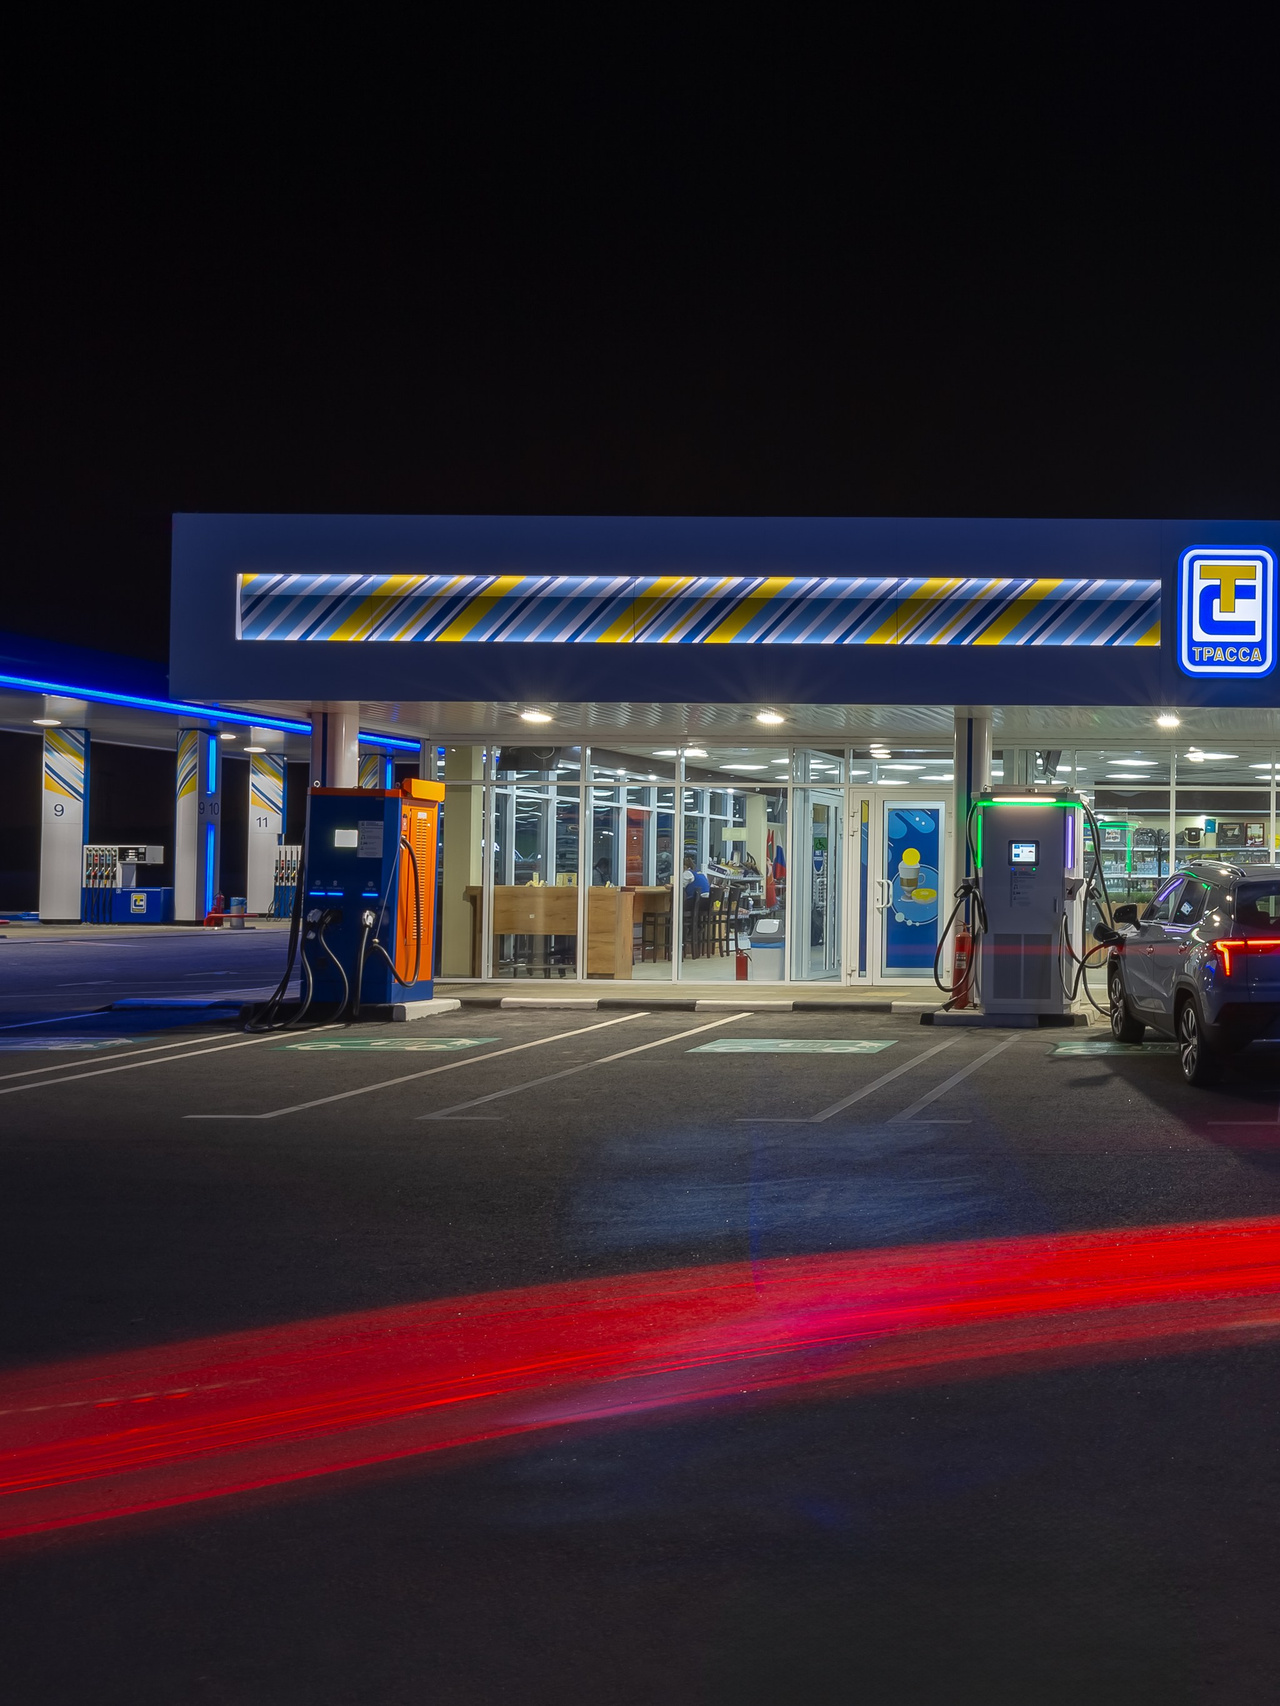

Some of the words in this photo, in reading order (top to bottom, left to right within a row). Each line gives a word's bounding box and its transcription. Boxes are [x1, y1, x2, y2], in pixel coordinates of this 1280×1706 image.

[1192, 646, 1262, 662] ТРАССА
[54, 803, 64, 817] 9
[198, 801, 205, 815] 9
[209, 802, 220, 816] 10
[256, 816, 268, 828] 11
